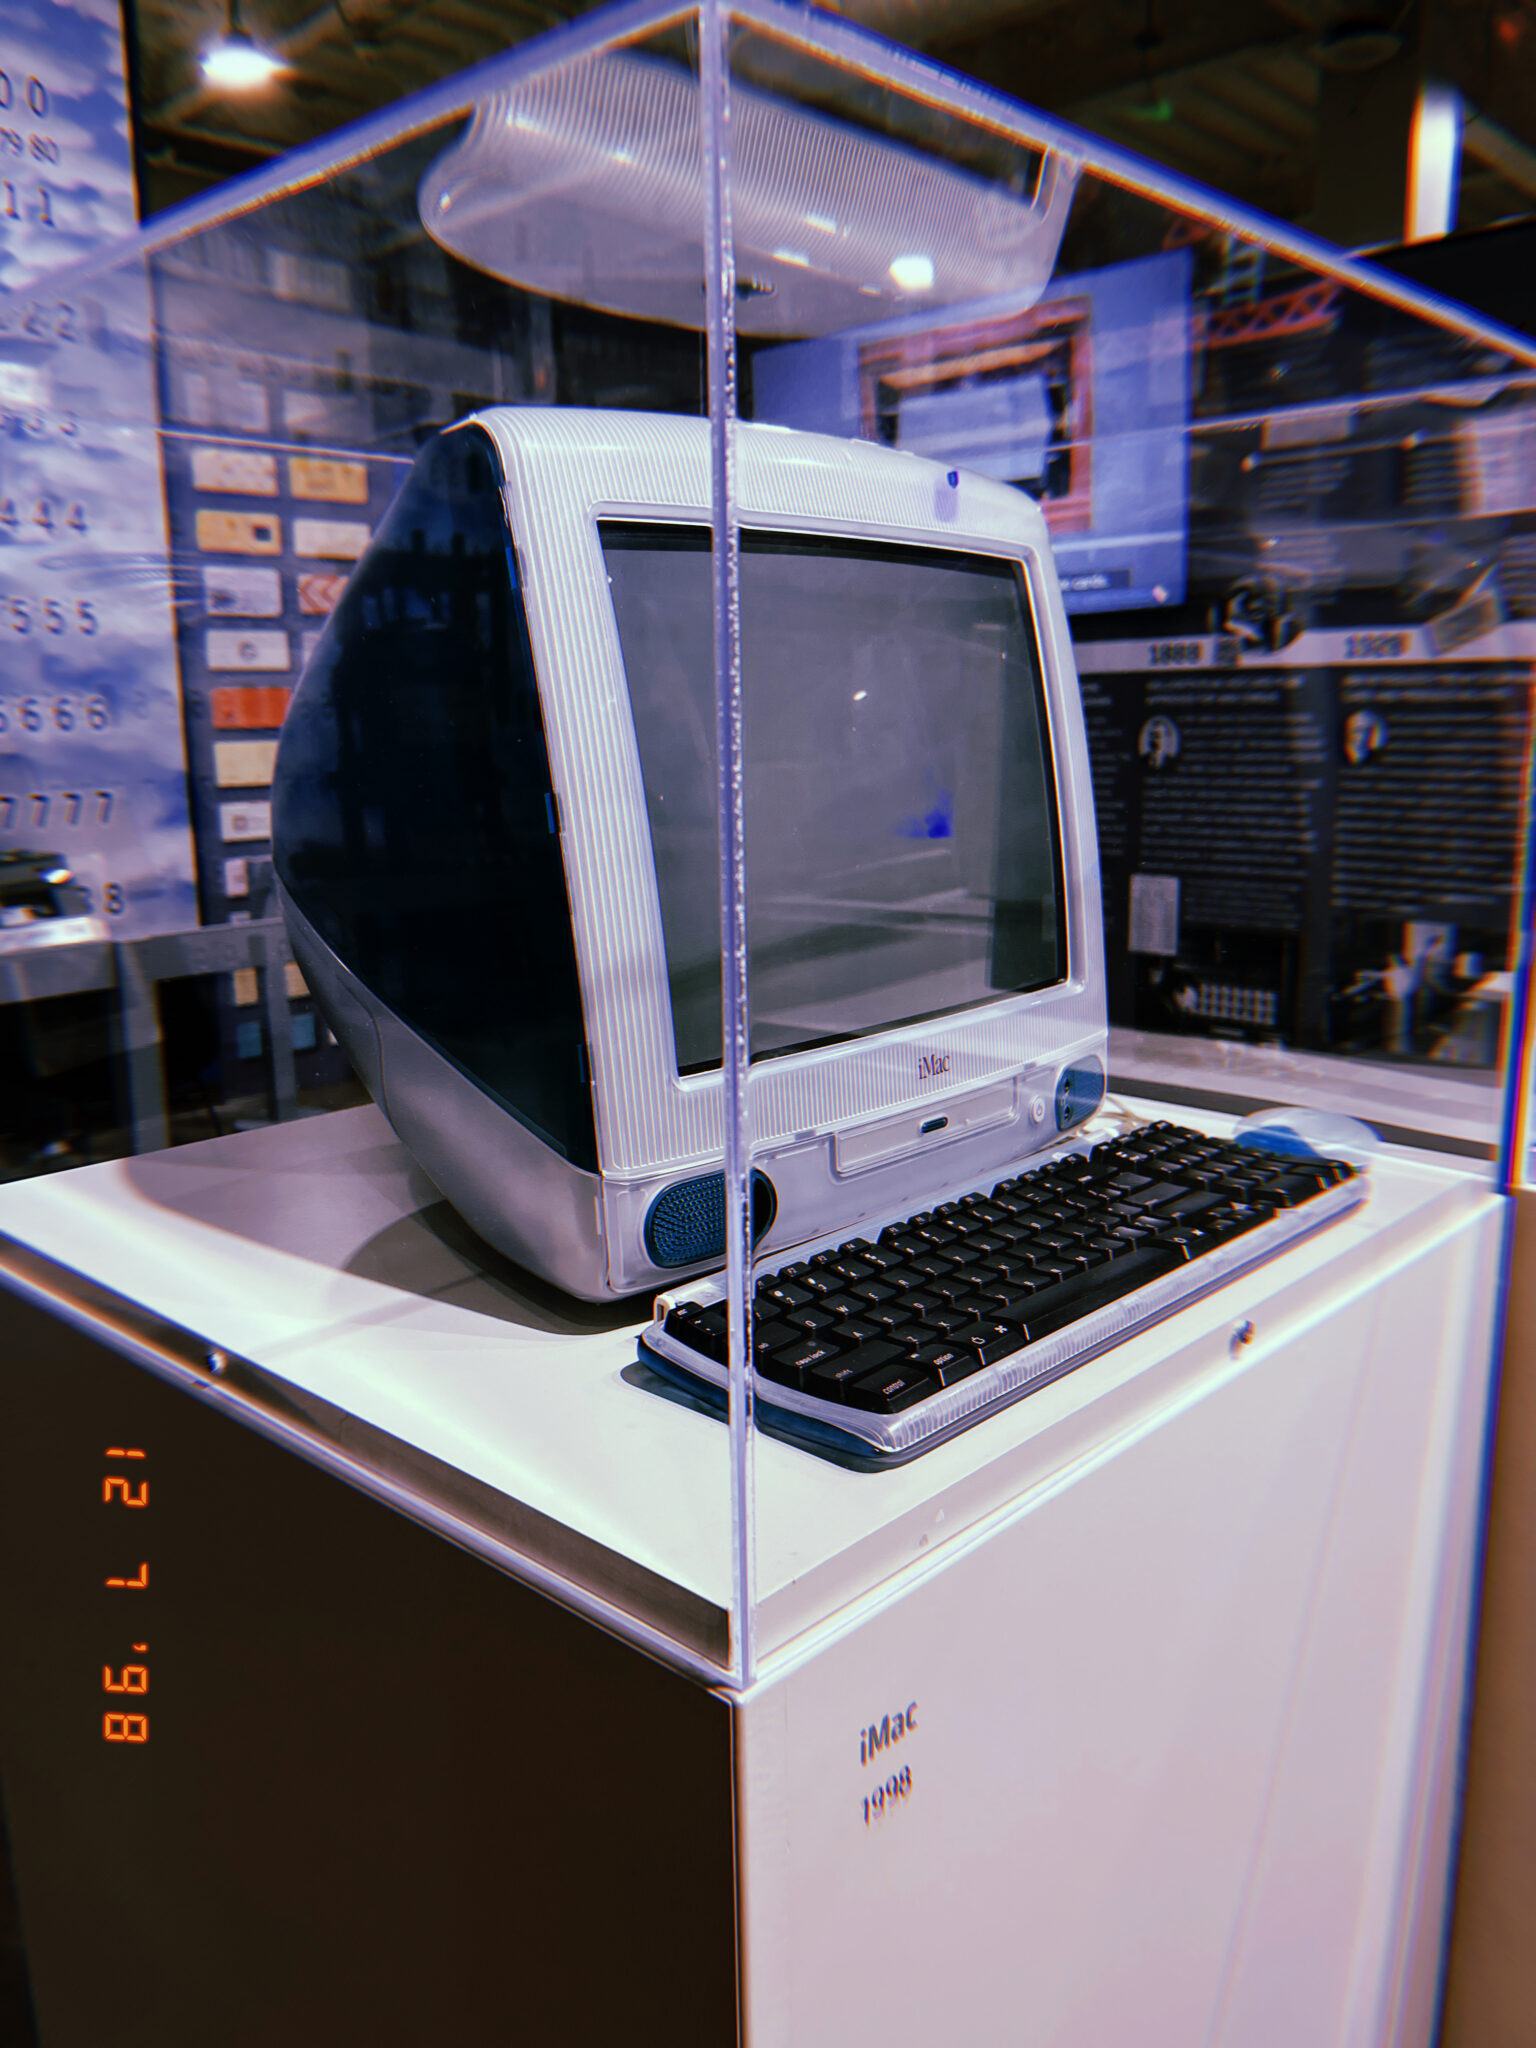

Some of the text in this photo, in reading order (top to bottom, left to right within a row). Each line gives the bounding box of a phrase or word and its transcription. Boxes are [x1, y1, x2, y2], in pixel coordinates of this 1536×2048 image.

[918, 1054, 951, 1080] iMac
[860, 1700, 919, 1768] iMac
[861, 1764, 914, 1828] 1998
